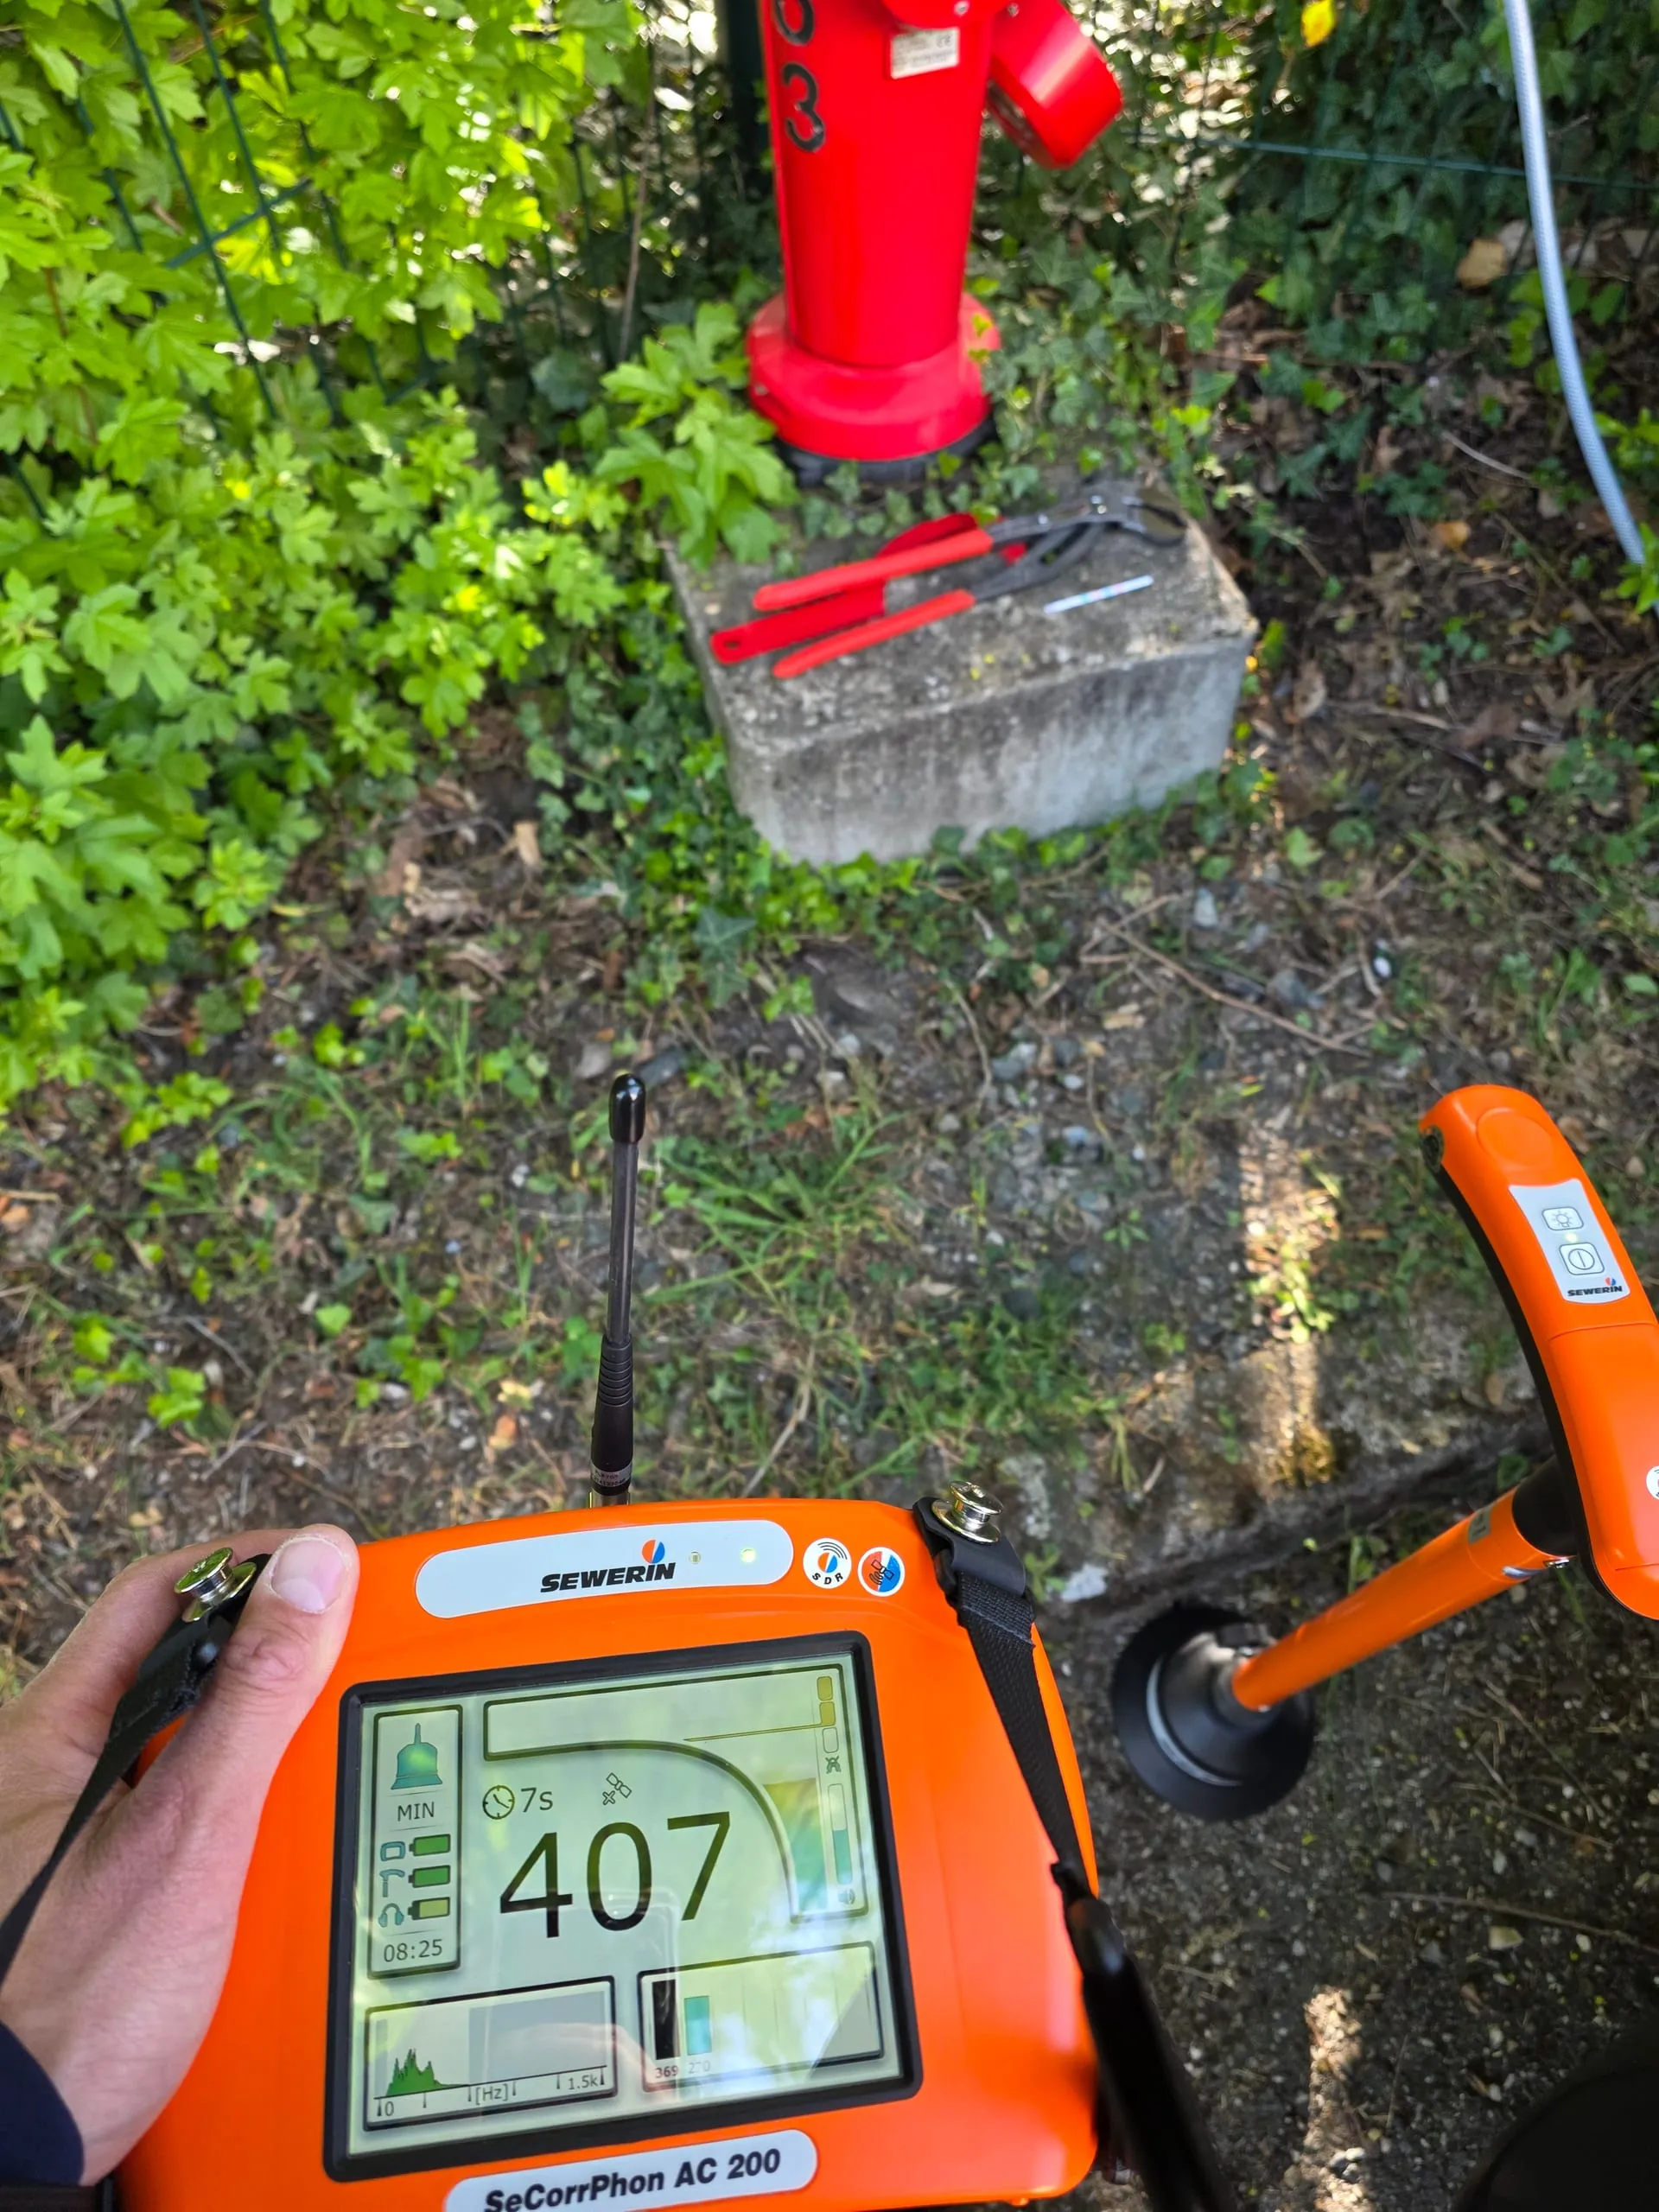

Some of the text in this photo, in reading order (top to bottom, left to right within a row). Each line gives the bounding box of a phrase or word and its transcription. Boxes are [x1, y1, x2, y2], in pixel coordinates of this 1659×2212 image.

[1567, 1286, 1623, 1297] SEWERIN
[540, 1562, 676, 1593] SEWERIN
[812, 1572, 844, 1586] SDR
[520, 1787, 554, 1814] 7s
[397, 1802, 435, 1821] MIN
[499, 1811, 731, 1938] 407
[383, 1939, 443, 1963] 08:25
[655, 2064, 678, 2079] 369
[568, 2074, 599, 2091] 1.5k
[385, 2101, 394, 2117] 0
[484, 2148, 781, 2212] SeCorrPhon AC 200
